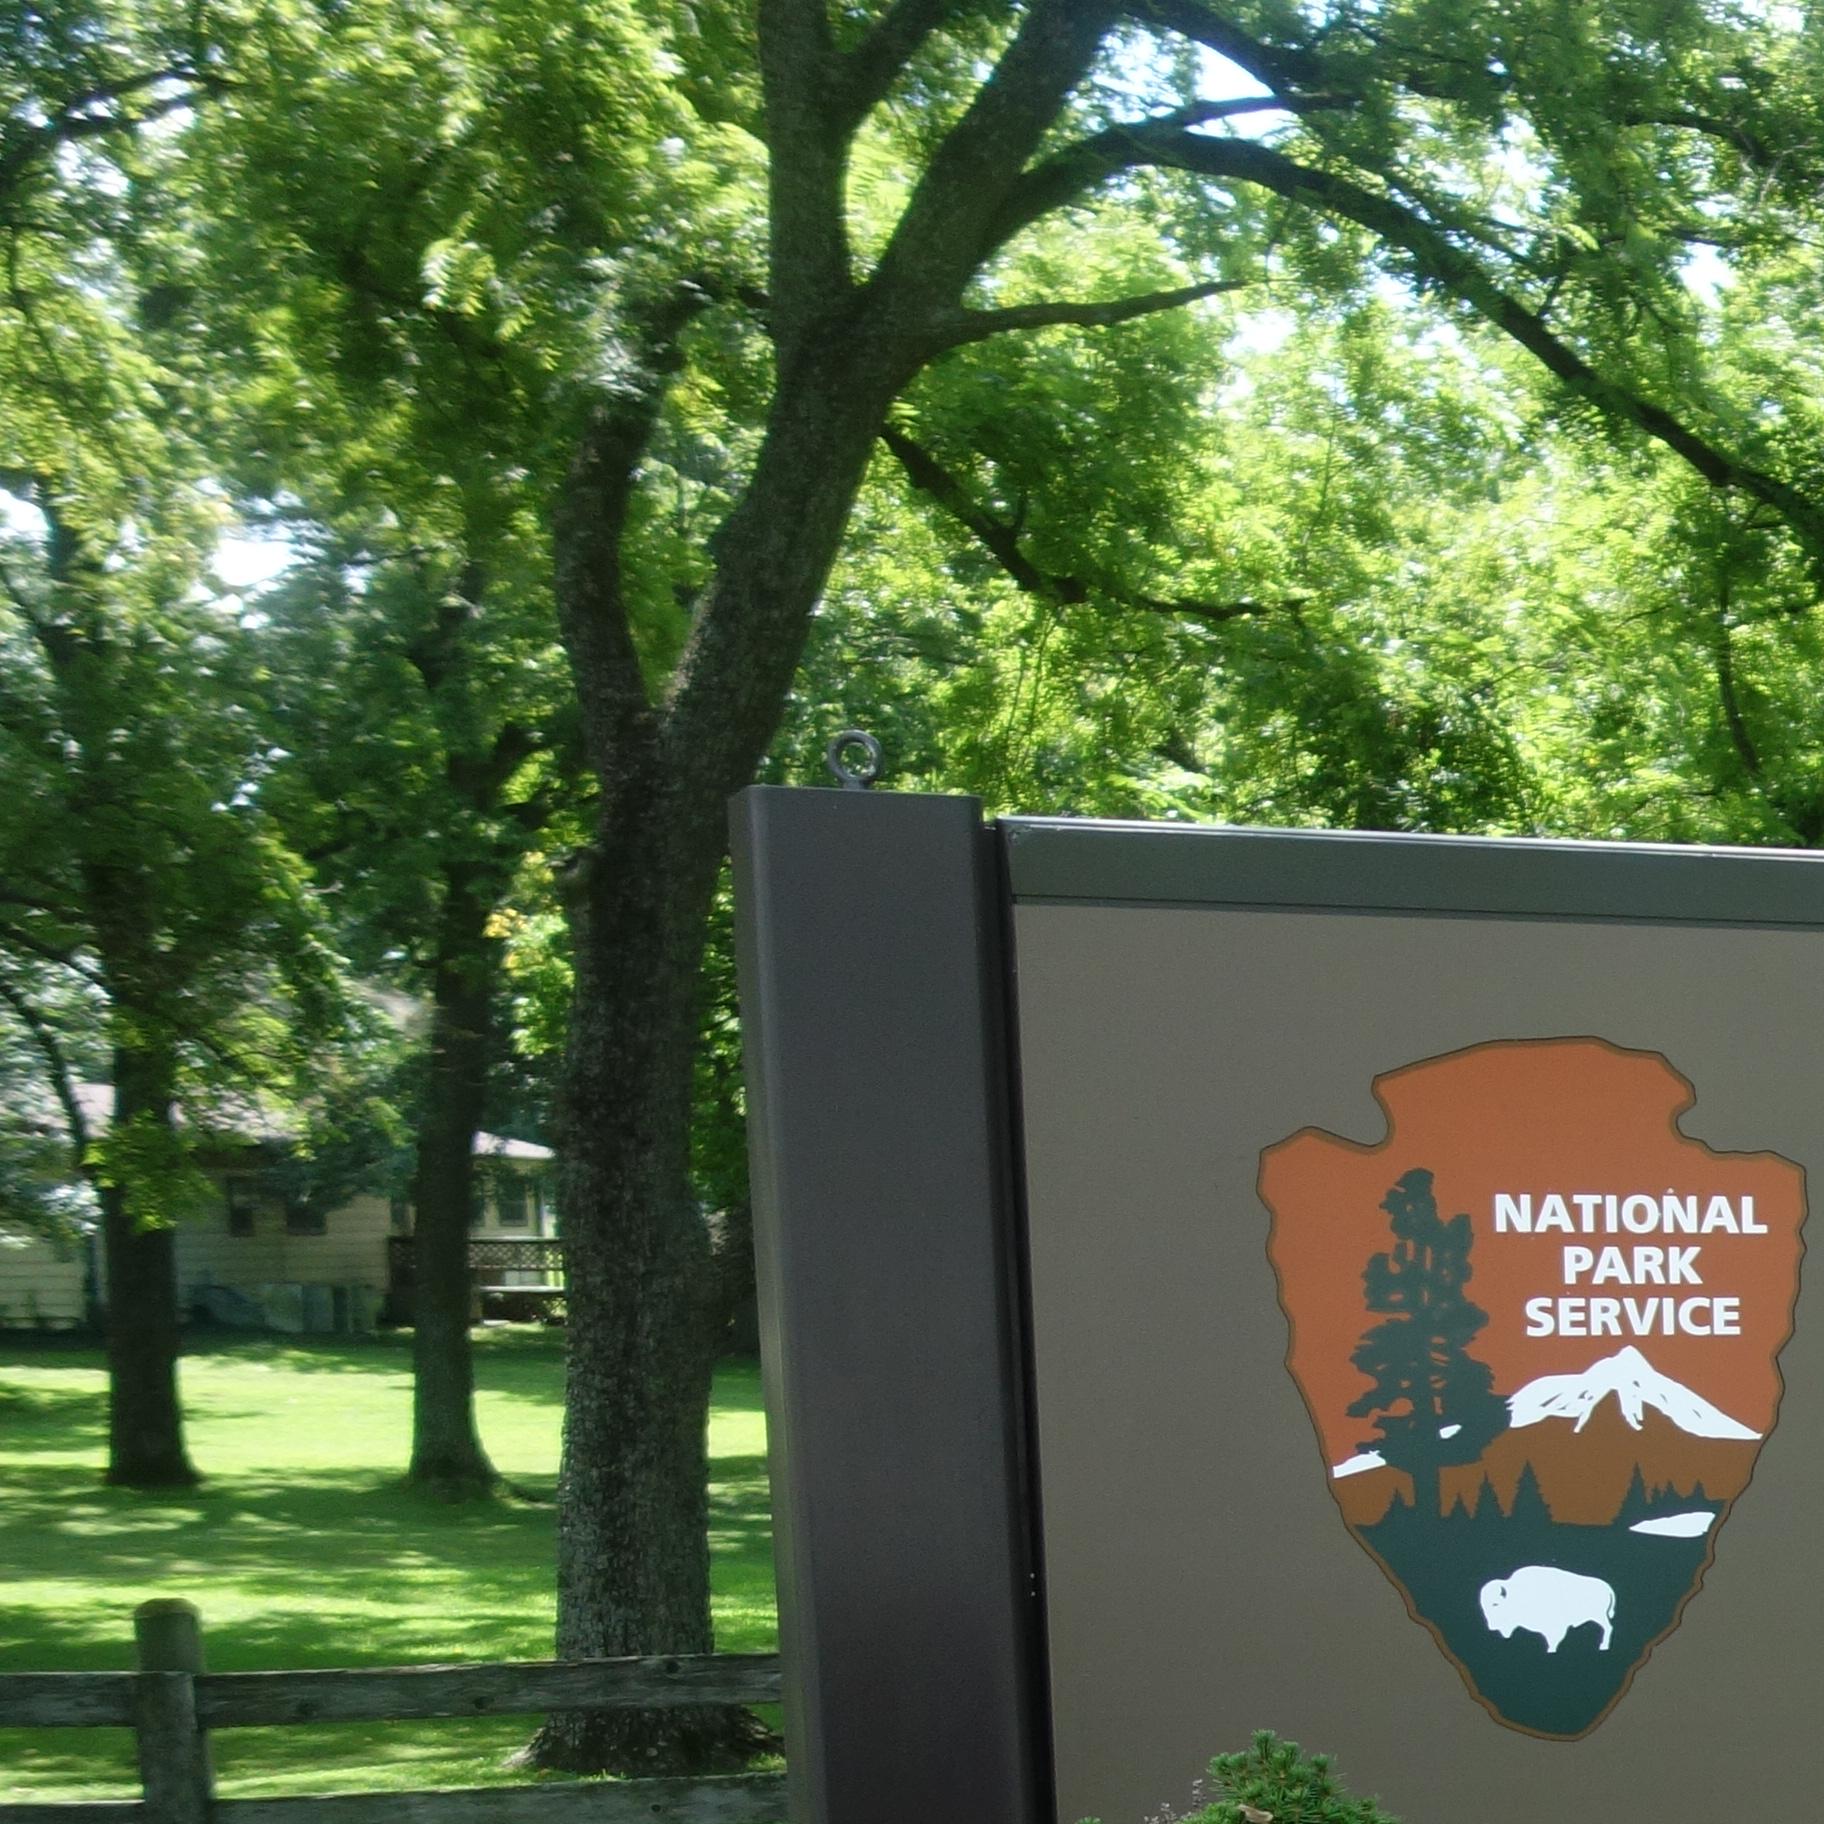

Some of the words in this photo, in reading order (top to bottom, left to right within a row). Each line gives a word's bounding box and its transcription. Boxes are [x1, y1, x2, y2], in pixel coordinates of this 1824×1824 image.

[1494, 1191, 1769, 1235] NATIONAL
[1562, 1245, 1704, 1285] PARK
[1524, 1296, 1741, 1338] SERVICE
